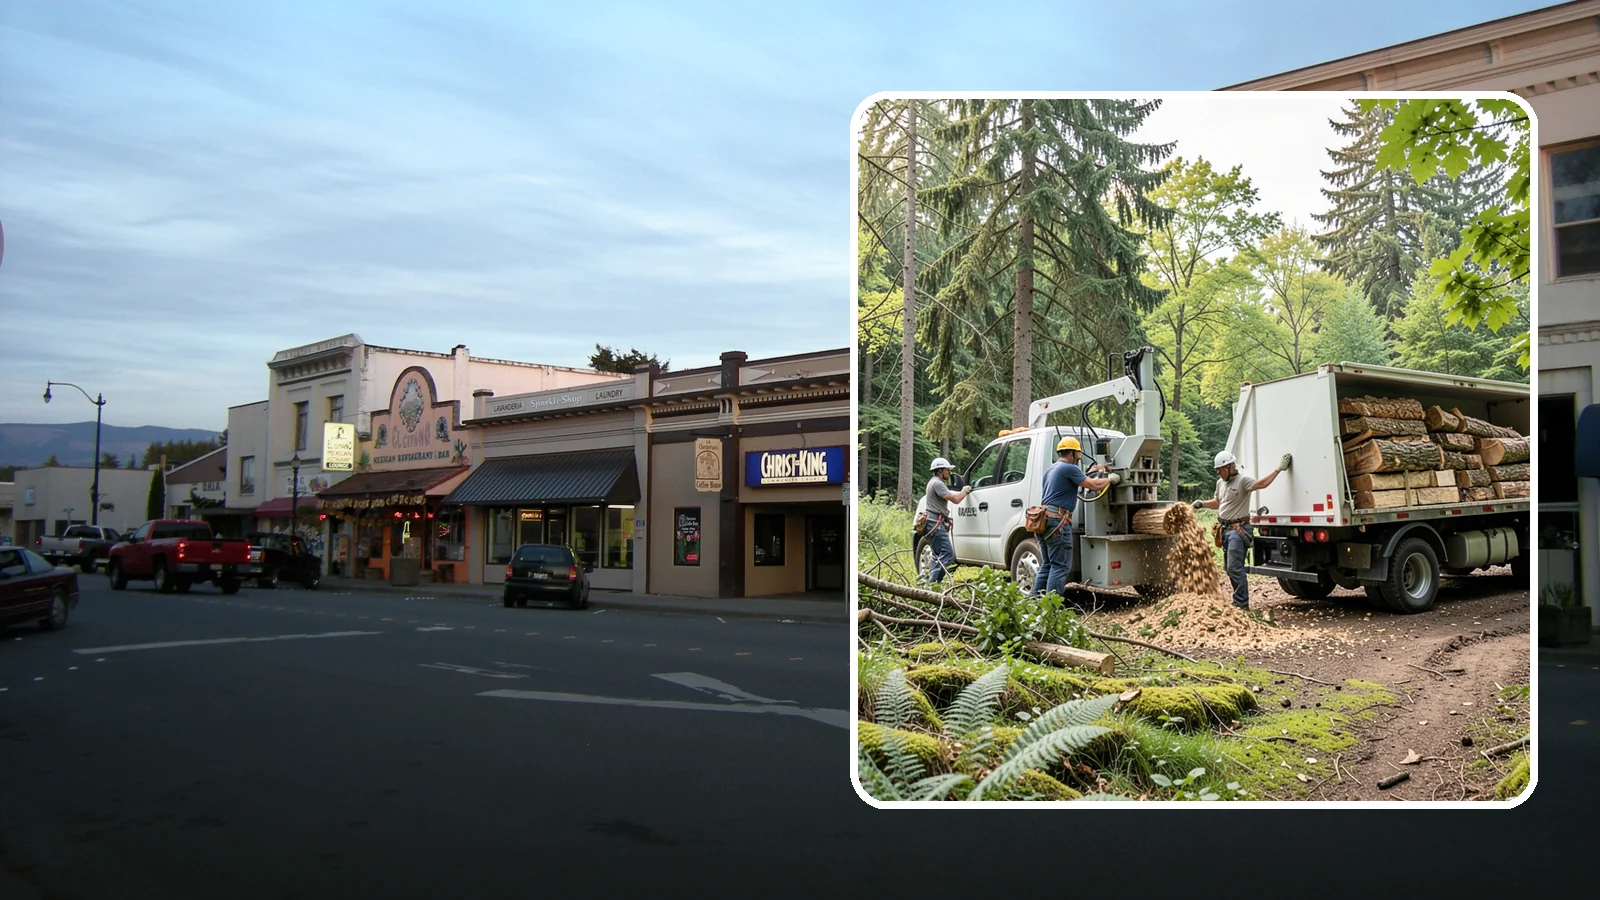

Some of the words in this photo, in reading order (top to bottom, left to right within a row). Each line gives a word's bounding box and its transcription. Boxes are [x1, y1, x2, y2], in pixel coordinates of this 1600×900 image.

[493, 402, 522, 412] LAVANDERIA
[530, 396, 560, 409] Sparkle
[561, 394, 582, 404] Shop
[596, 389, 624, 400] LAUNDRY
[373, 454, 396, 464] MEXICAN
[397, 451, 433, 462] RESTAURANT
[438, 450, 450, 459] BAR
